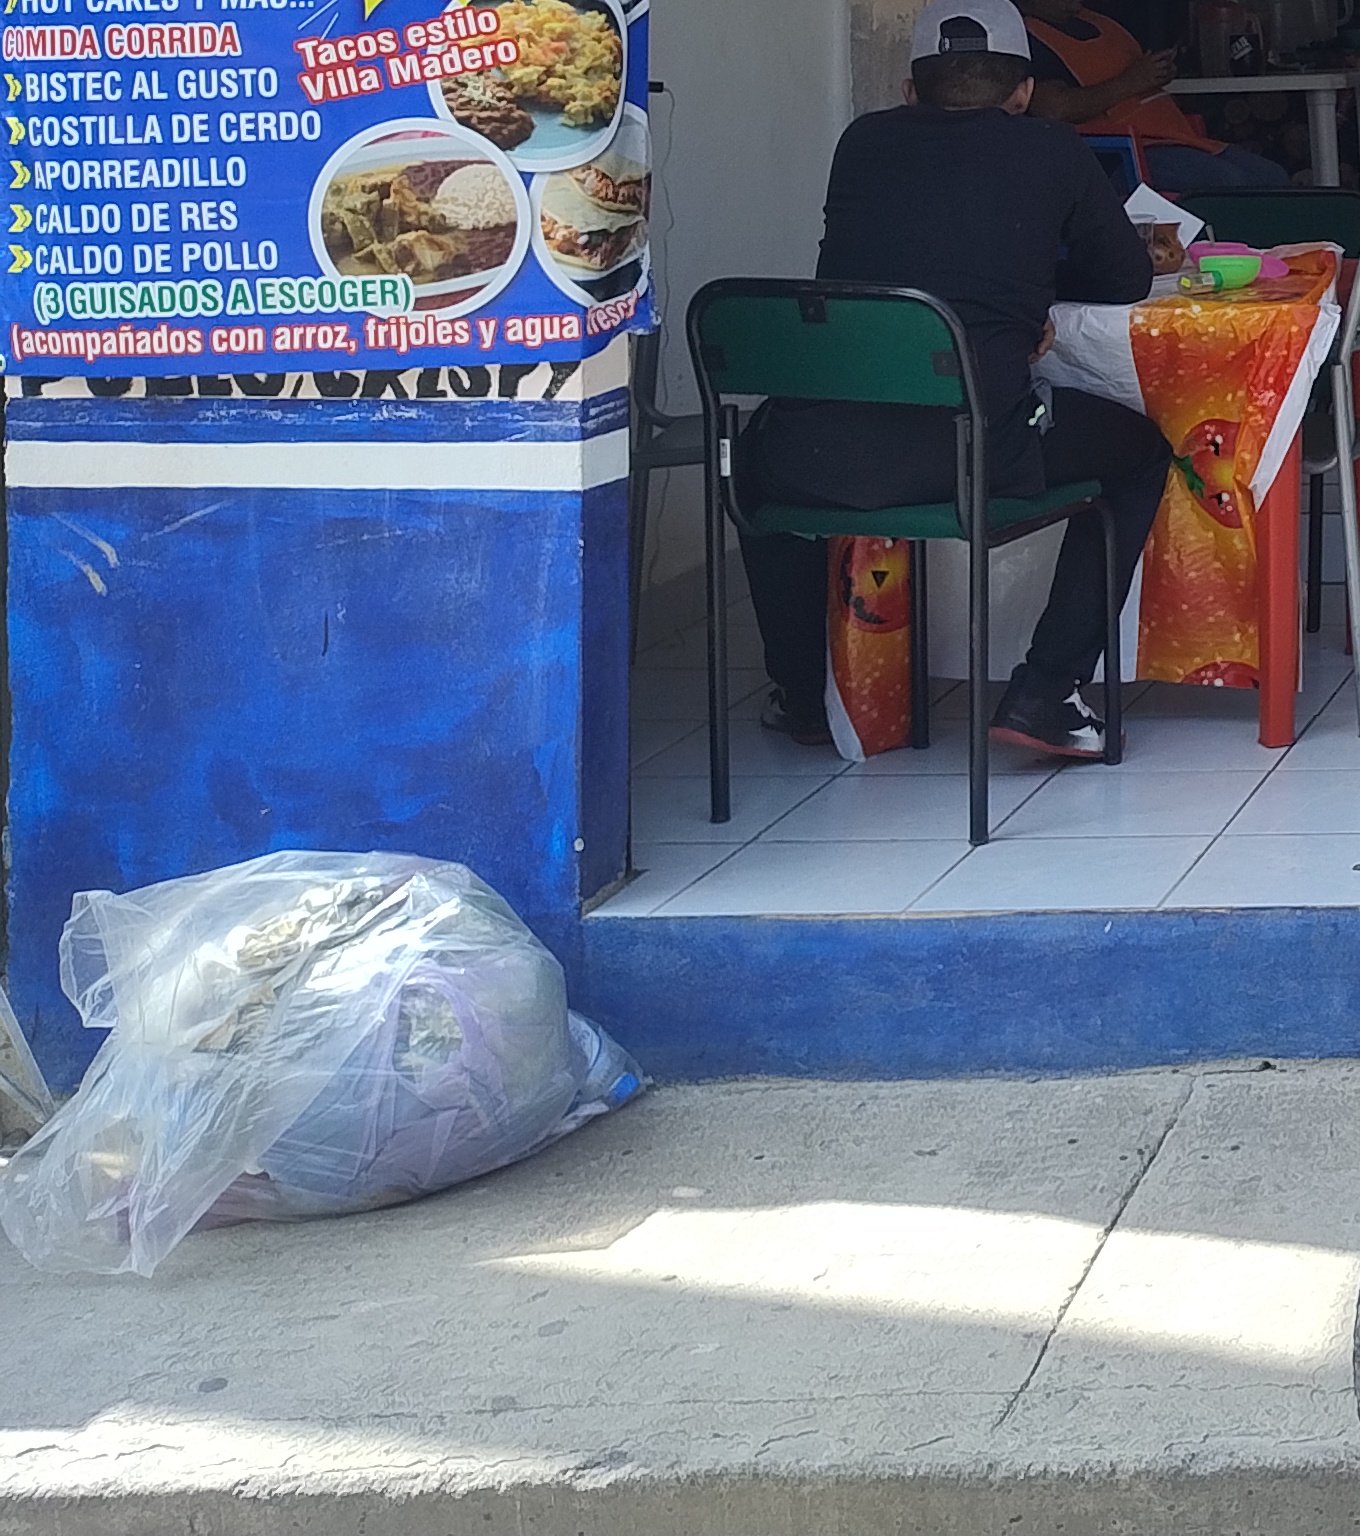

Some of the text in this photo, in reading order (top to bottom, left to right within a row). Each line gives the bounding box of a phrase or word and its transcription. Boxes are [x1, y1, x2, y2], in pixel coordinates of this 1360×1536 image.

[3, 21, 242, 61] COMIDA CORRIDA
[295, 6, 501, 68] Tacos estilo
[25, 67, 278, 103] BISTEC AL GUSTO
[299, 36, 520, 103] Villa Madero
[28, 110, 322, 147] COSTILLA DE CERDO
[34, 156, 247, 191] APORREADILLO
[34, 200, 238, 235] CALDO DE RES
[34, 240, 278, 276] CALDO DE POLLO
[33, 274, 415, 325] (3 GUISADOS A ESCOGER)
[11, 323, 202, 362] (acompañados
[211, 325, 265, 354] con
[273, 321, 358, 354] arroz,
[365, 316, 471, 354] frijoles
[477, 316, 497, 349] y
[505, 313, 583, 347] agua
